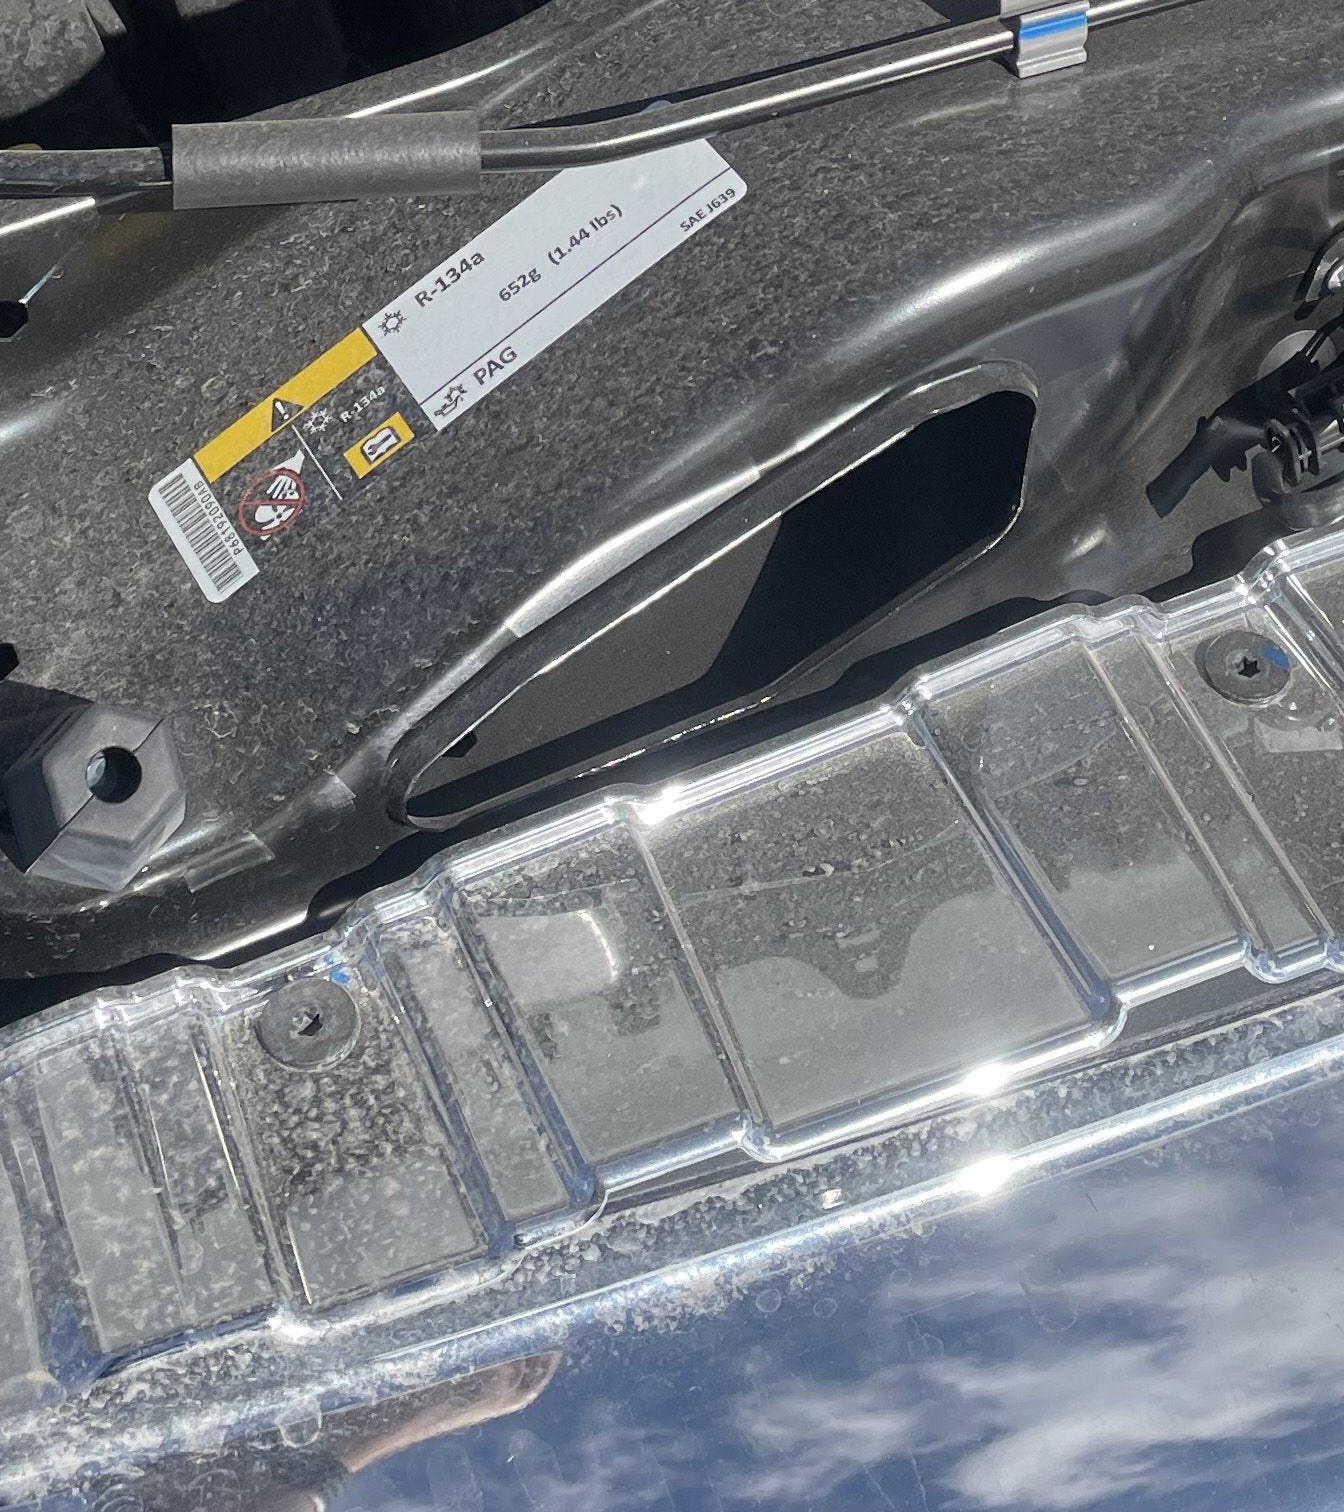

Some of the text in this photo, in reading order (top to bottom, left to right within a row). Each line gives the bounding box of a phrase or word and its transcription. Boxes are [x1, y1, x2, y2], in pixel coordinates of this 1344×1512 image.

[680, 188, 736, 232] SAE J639
[498, 204, 623, 302] 652g (1.44 lbs)
[414, 252, 486, 308] R-134a
[473, 346, 518, 386] PAG
[340, 385, 386, 422] R-134a
[193, 480, 244, 556] P68192090AB
